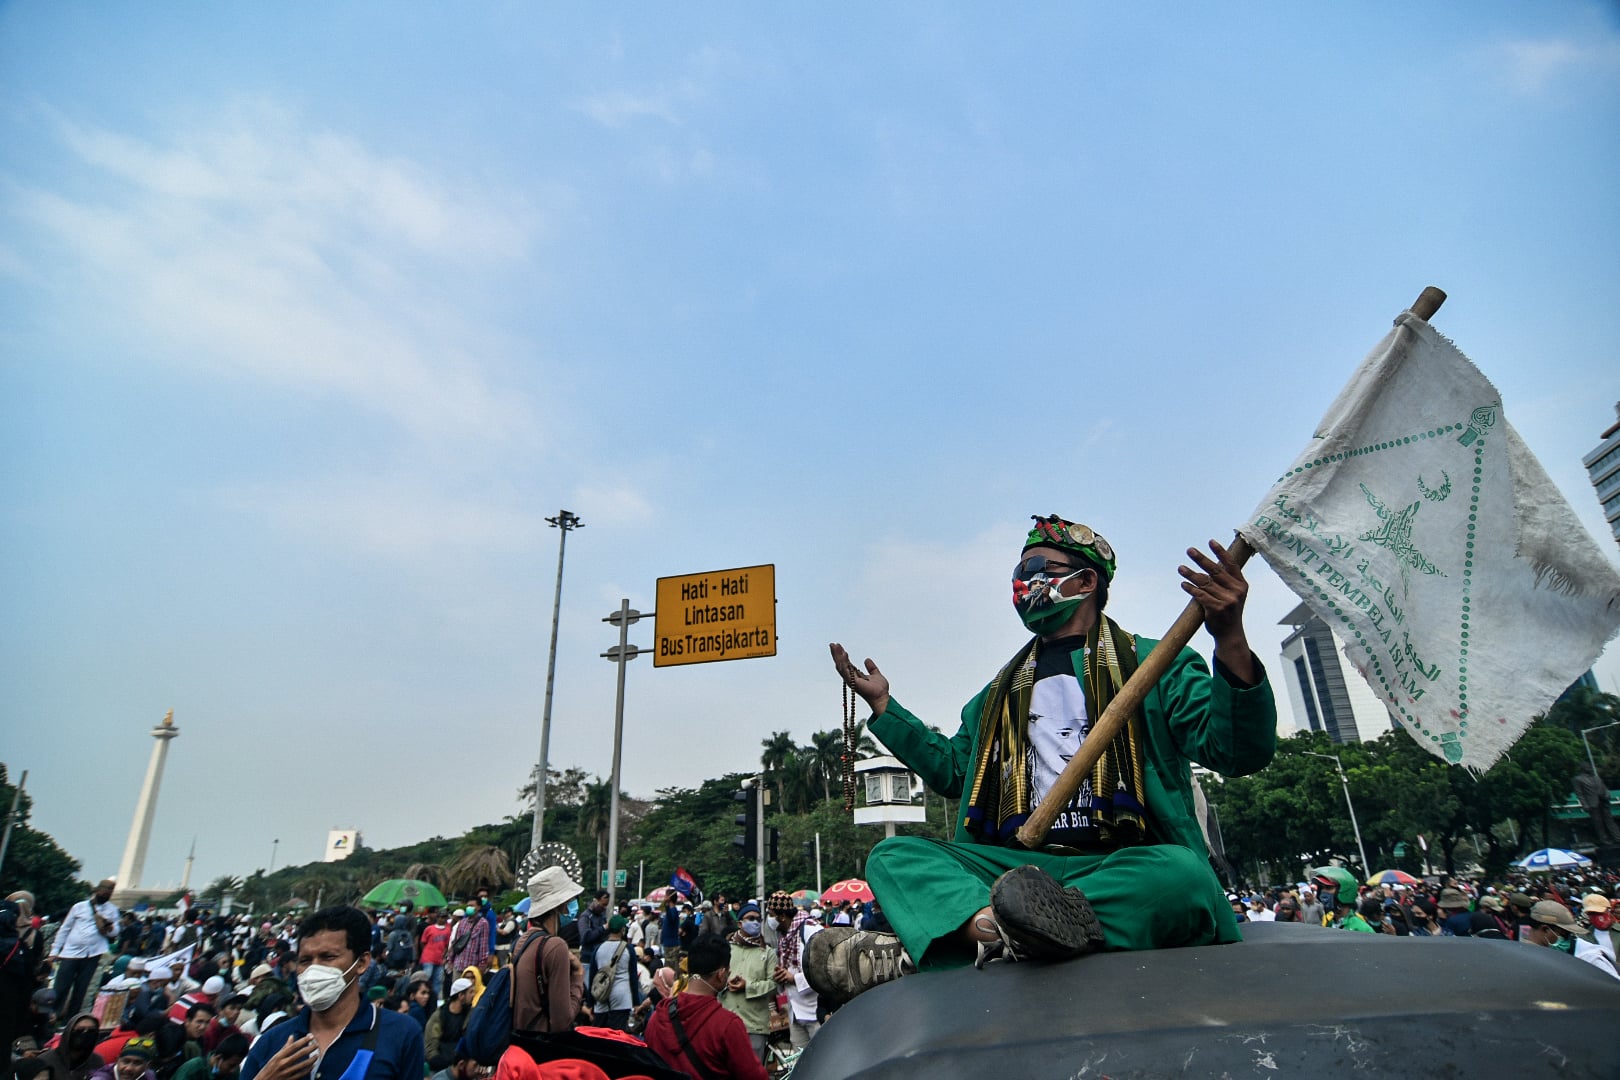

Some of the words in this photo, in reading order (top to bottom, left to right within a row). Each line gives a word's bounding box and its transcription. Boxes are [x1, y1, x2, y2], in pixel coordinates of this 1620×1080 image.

[681, 578, 708, 601] Hati
[721, 573, 749, 596] Hati
[684, 604, 744, 626] Lintasan
[1255, 515, 1320, 566] FRONT
[1316, 560, 1392, 645] PEMBELA
[1388, 641, 1427, 701] ISLAM
[660, 637, 684, 657] Bus
[684, 626, 769, 656] Transjakarta
[1070, 811, 1089, 828] Bin
